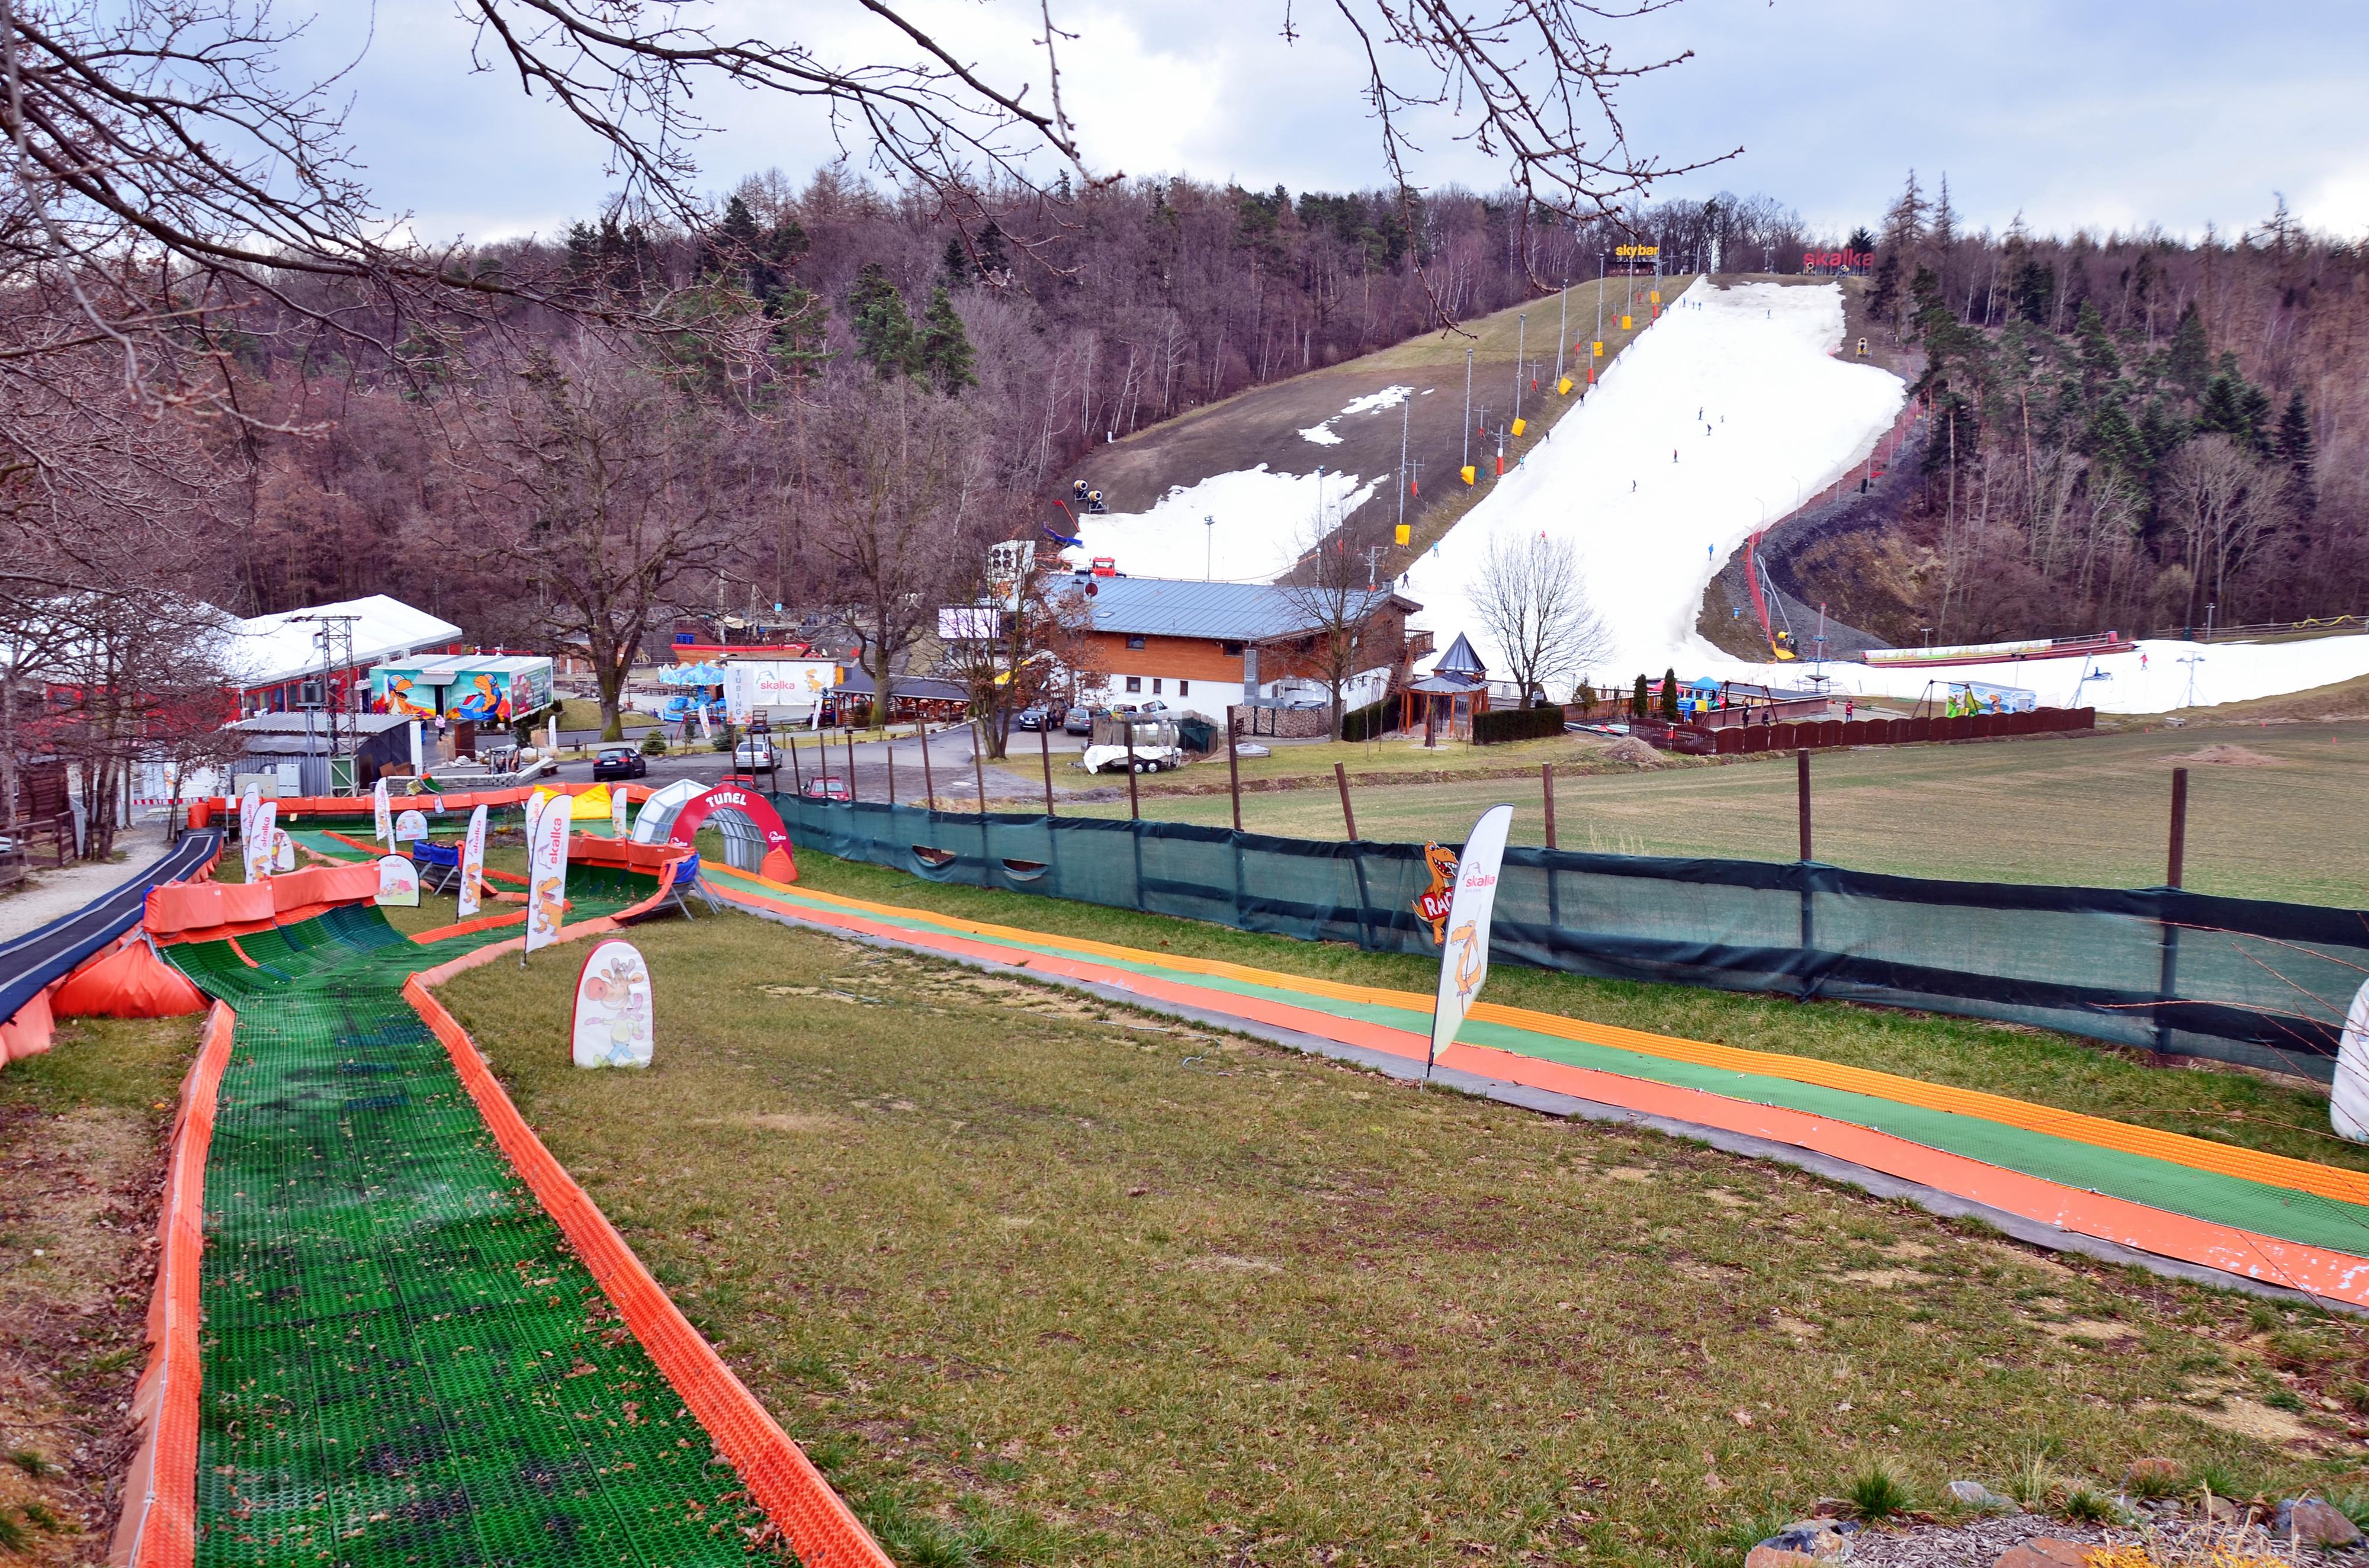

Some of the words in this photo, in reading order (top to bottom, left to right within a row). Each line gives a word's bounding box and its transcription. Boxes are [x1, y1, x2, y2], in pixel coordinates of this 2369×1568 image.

[1803, 248, 1876, 266] skalka
[760, 681, 795, 690] skalka
[705, 792, 747, 807] TUNEL
[261, 817, 270, 847] skalka
[473, 820, 481, 854] skalka
[549, 818, 562, 865] skalka
